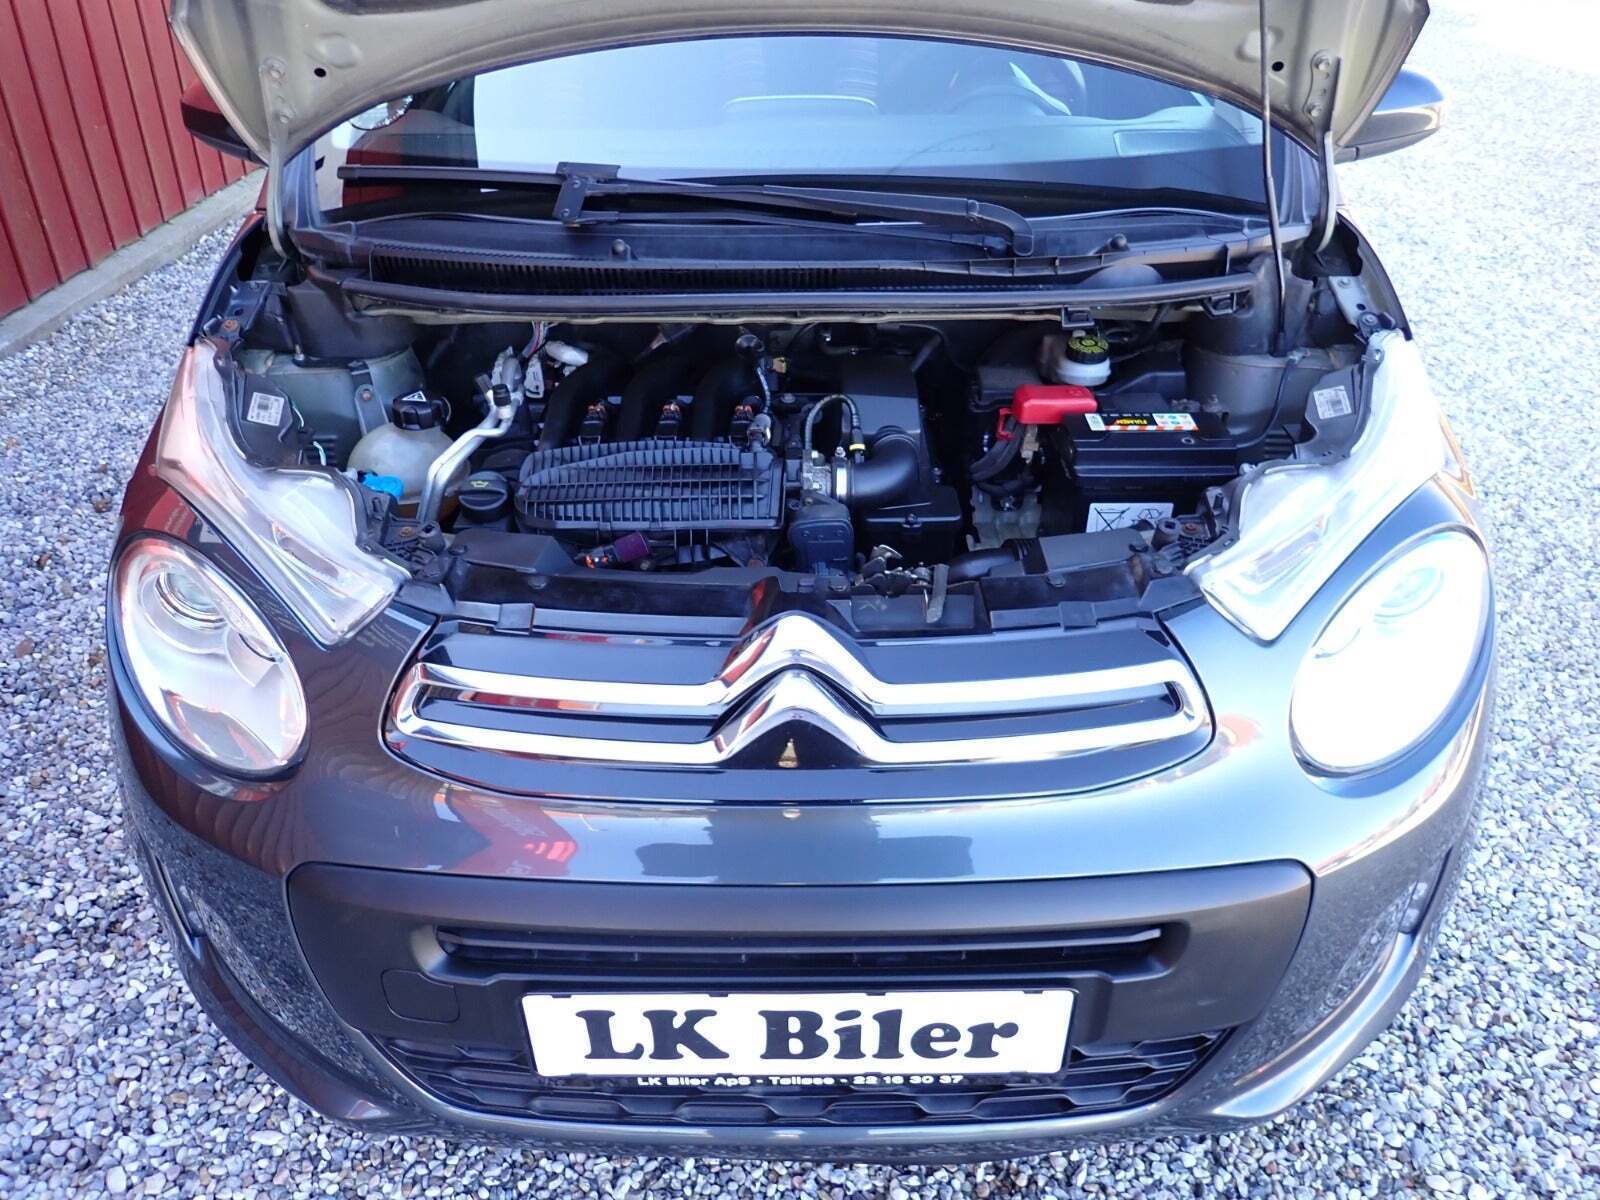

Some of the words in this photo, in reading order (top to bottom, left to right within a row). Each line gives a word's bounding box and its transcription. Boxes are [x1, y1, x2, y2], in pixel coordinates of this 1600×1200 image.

[576, 1010, 730, 1060] LK
[758, 1010, 1019, 1060] Biler
[637, 1076, 662, 1086] LK
[666, 1076, 710, 1086] Biler
